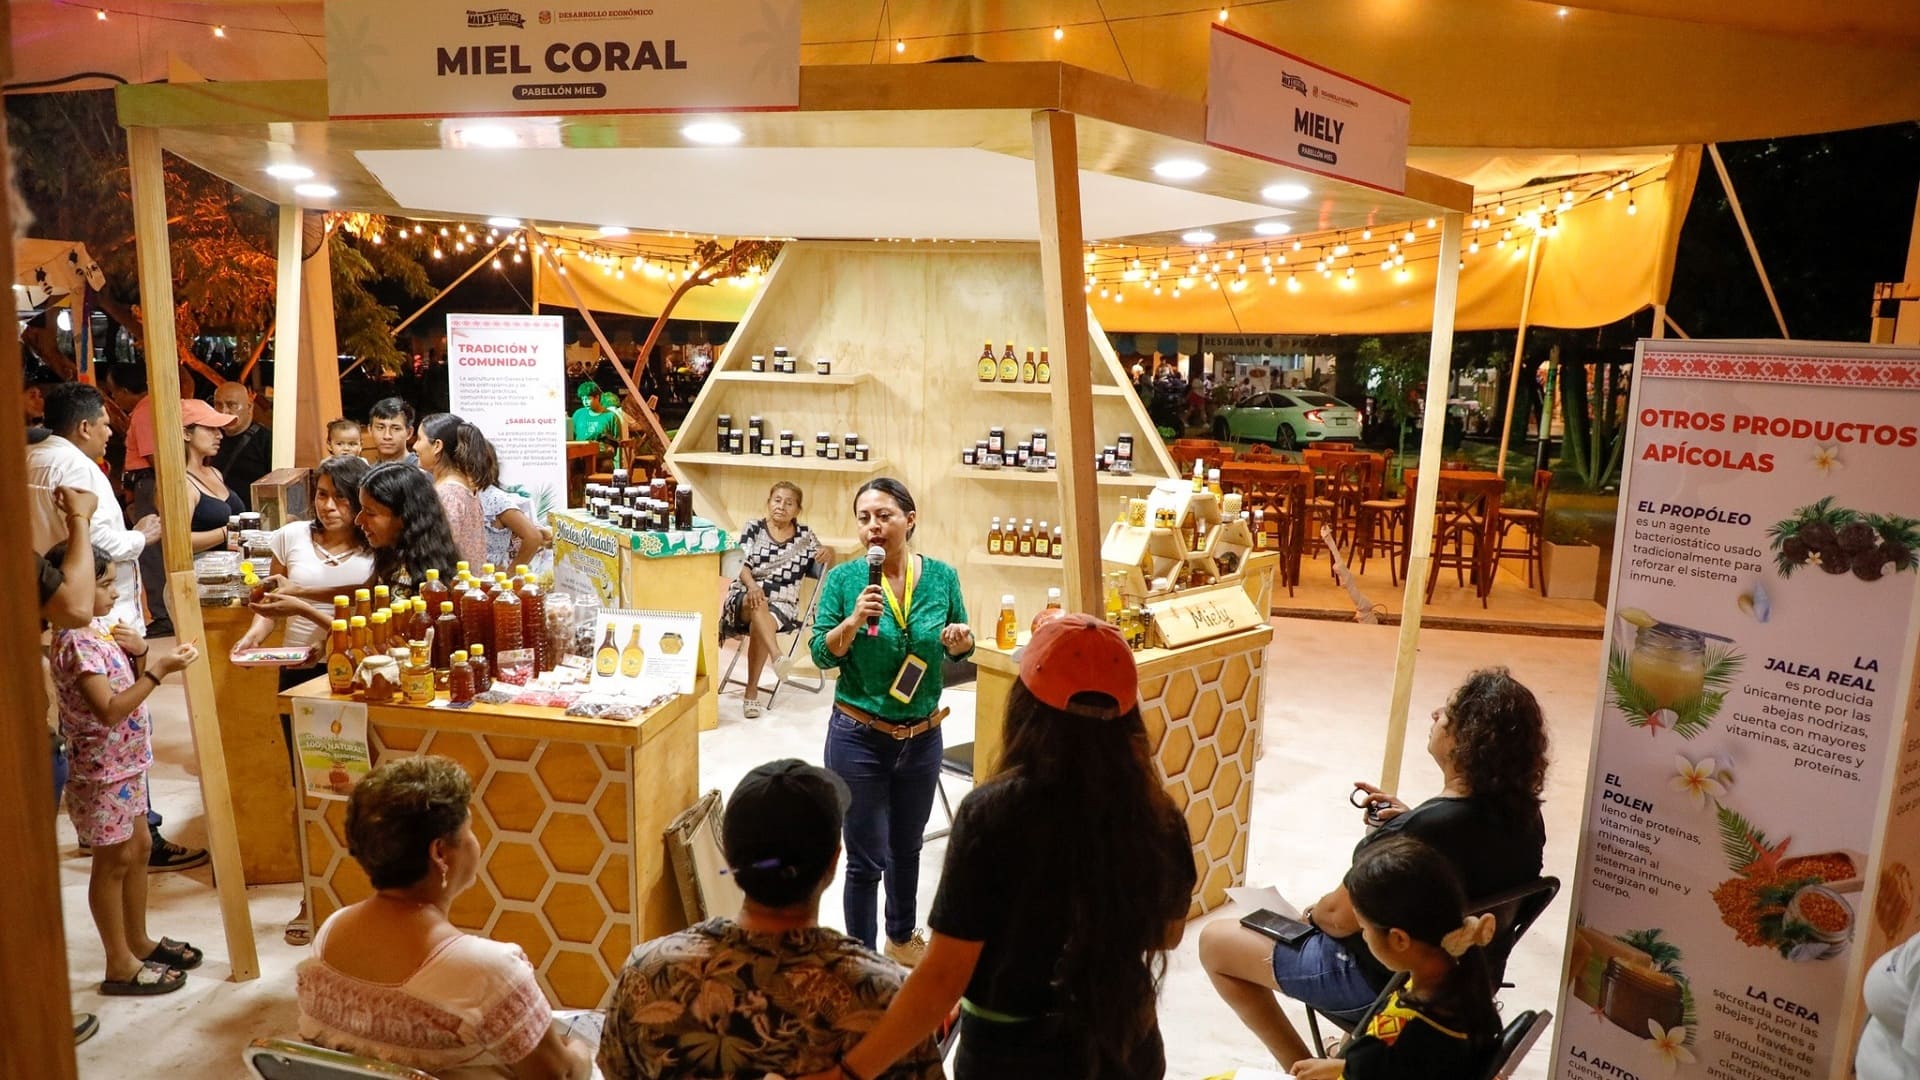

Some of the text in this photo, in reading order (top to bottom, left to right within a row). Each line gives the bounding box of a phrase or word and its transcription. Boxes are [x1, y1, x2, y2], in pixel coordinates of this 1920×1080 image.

[559, 8, 653, 19] DESARROLLO ECONÓMICO
[437, 40, 688, 76] MIEL CORAL
[521, 85, 598, 97] PABELLÓN MIEL
[1294, 107, 1345, 144] MIELY
[458, 341, 539, 353] TRADICIÓN Y
[459, 357, 537, 367] COMUNIDAD
[1640, 408, 1918, 448] OTROS PRODUCTOS
[1642, 441, 1775, 473] APÍCOLAS
[1636, 518, 1711, 535] es un agente
[1637, 501, 1752, 526] EL PROPÓLEO
[1634, 530, 1762, 557] bacteriostático usado
[1631, 558, 1738, 583] reforzar el sistema
[1633, 544, 1762, 573] tradicionalmente para
[1630, 570, 1676, 587] inmune.
[1190, 600, 1235, 629] Miely
[1764, 657, 1876, 692] JALEA REAL
[1854, 656, 1879, 673] LA
[1743, 684, 1871, 722] únicamente por las
[1785, 680, 1873, 707] es producida
[1733, 712, 1867, 752] cuenta con mayores
[1762, 704, 1868, 739] abejas nodrizas,
[1726, 724, 1865, 769] vitaminas, azúcares y
[1605, 773, 1622, 787] EL
[1794, 757, 1861, 782] proteínas.
[1602, 789, 1654, 814] POLEN
[1600, 817, 1661, 845] vitaminas y
[1601, 803, 1701, 845] lleno de proteínas,
[1596, 842, 1659, 870] refuerzan al
[1598, 830, 1653, 855] minerales,
[1592, 878, 1631, 899] cuerpo.
[1594, 867, 1659, 896] energizan el
[1595, 854, 1691, 895] sistema inmune y
[1713, 989, 1819, 1038] secretada por las
[1746, 986, 1820, 1025] LA CERA
[1715, 1003, 1816, 1051] abejas jóvenes a
[1570, 1045, 1587, 1061] LA
[1756, 1033, 1814, 1065] través de
[1779, 1057, 1811, 1078] tiene
